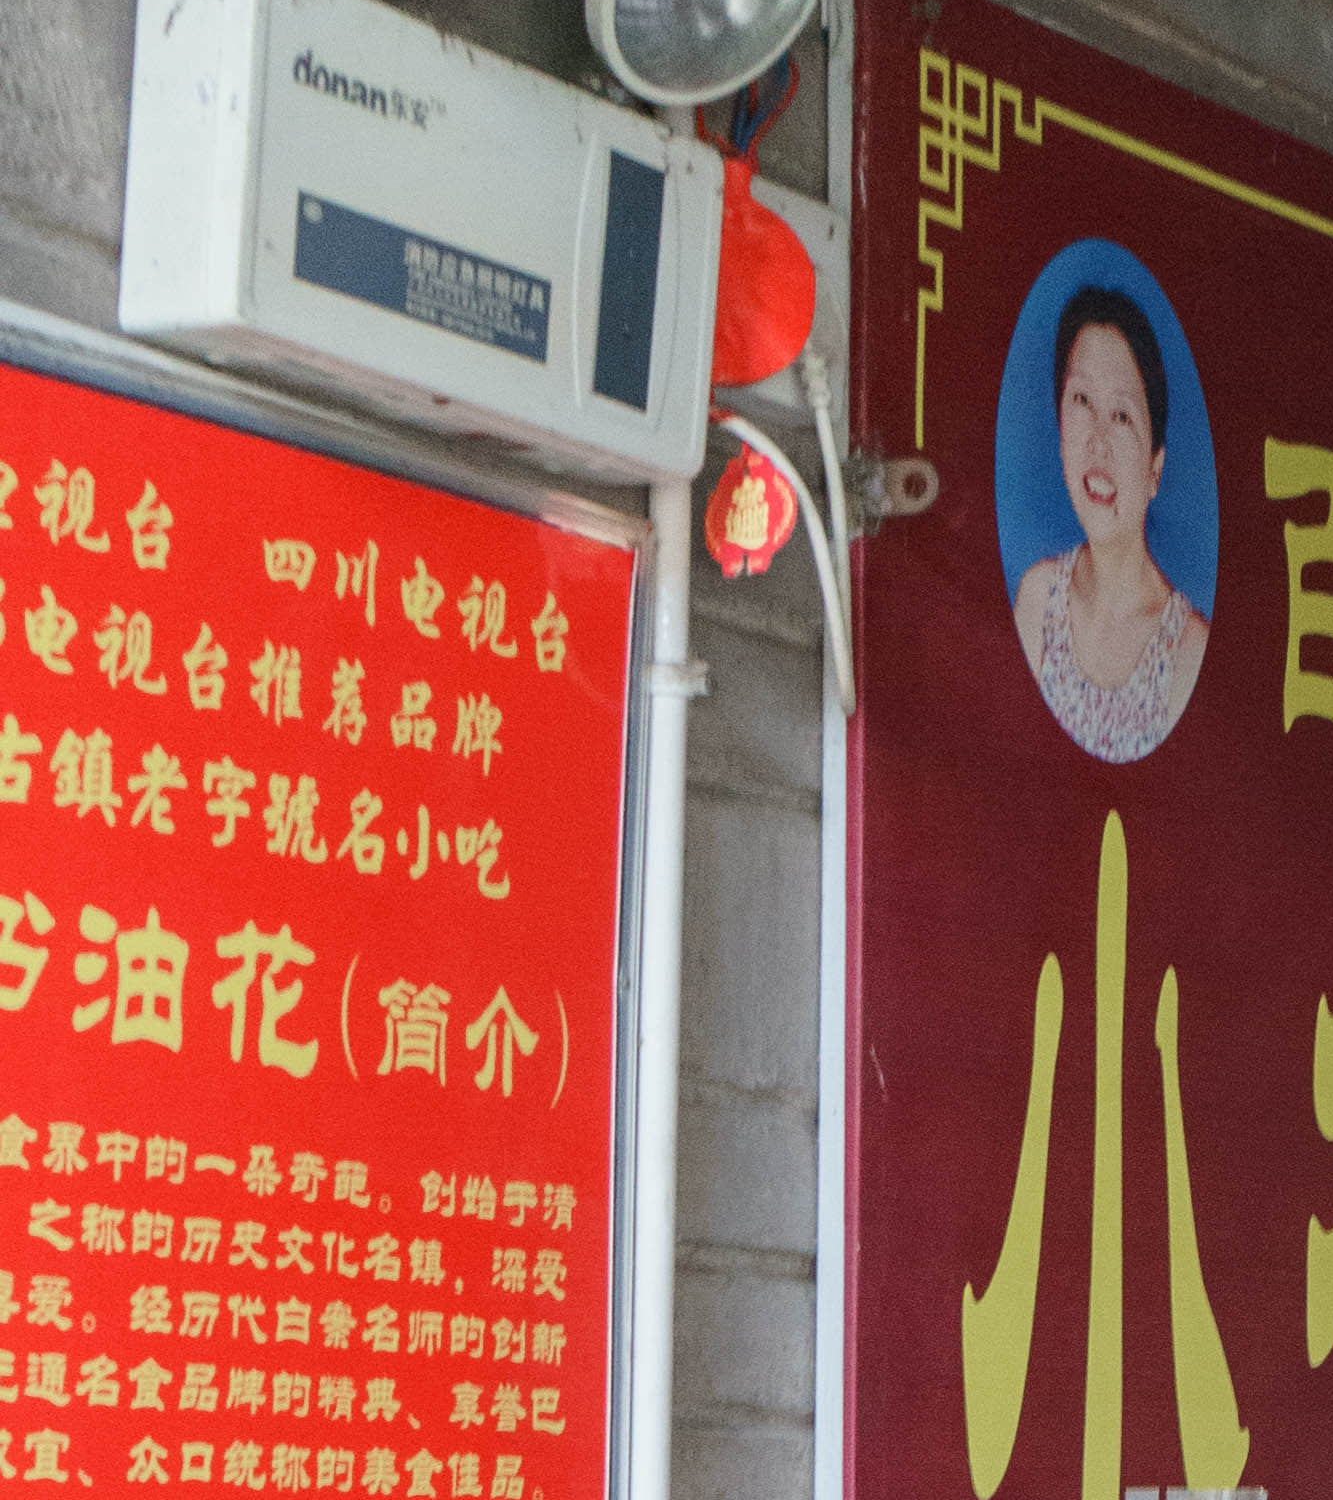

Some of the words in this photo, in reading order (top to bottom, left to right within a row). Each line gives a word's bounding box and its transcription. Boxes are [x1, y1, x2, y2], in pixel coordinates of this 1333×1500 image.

[0, 576, 504, 778] 电视台推荐品牌
[263, 536, 570, 674] 四川电视台
